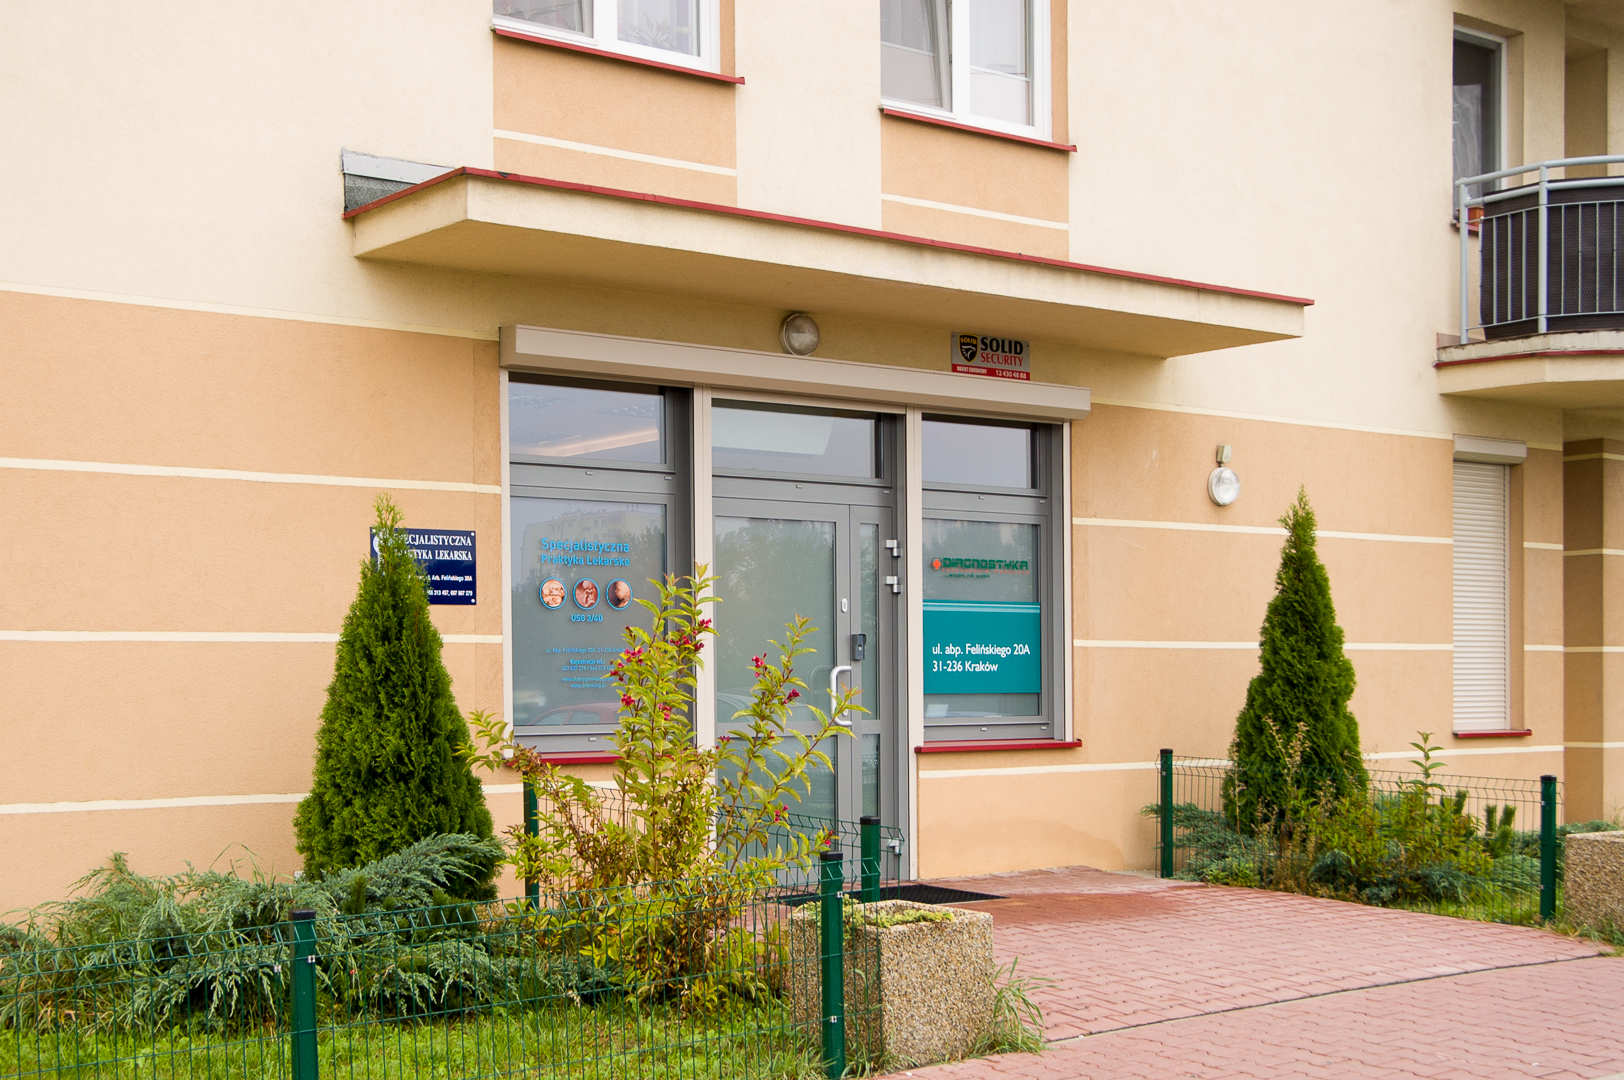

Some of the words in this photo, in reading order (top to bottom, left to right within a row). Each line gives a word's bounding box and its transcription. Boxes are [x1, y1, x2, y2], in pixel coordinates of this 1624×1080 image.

[960, 336, 977, 344] SOLID
[980, 336, 1024, 355] SOLID
[980, 352, 1024, 366] SECURITY
[541, 537, 630, 554] Specjalistyczna
[435, 550, 472, 560] LEKARSKA
[541, 554, 584, 566] Praktyka
[586, 555, 630, 566] Lekarska
[570, 614, 586, 622] USG
[587, 614, 604, 622] 3/4D
[932, 643, 942, 654] ul.
[945, 643, 963, 657] abp.
[966, 643, 1011, 658] Felińskiego
[1013, 644, 1030, 655] 20A
[932, 660, 963, 671] 31-236
[965, 660, 998, 671] Kraków
